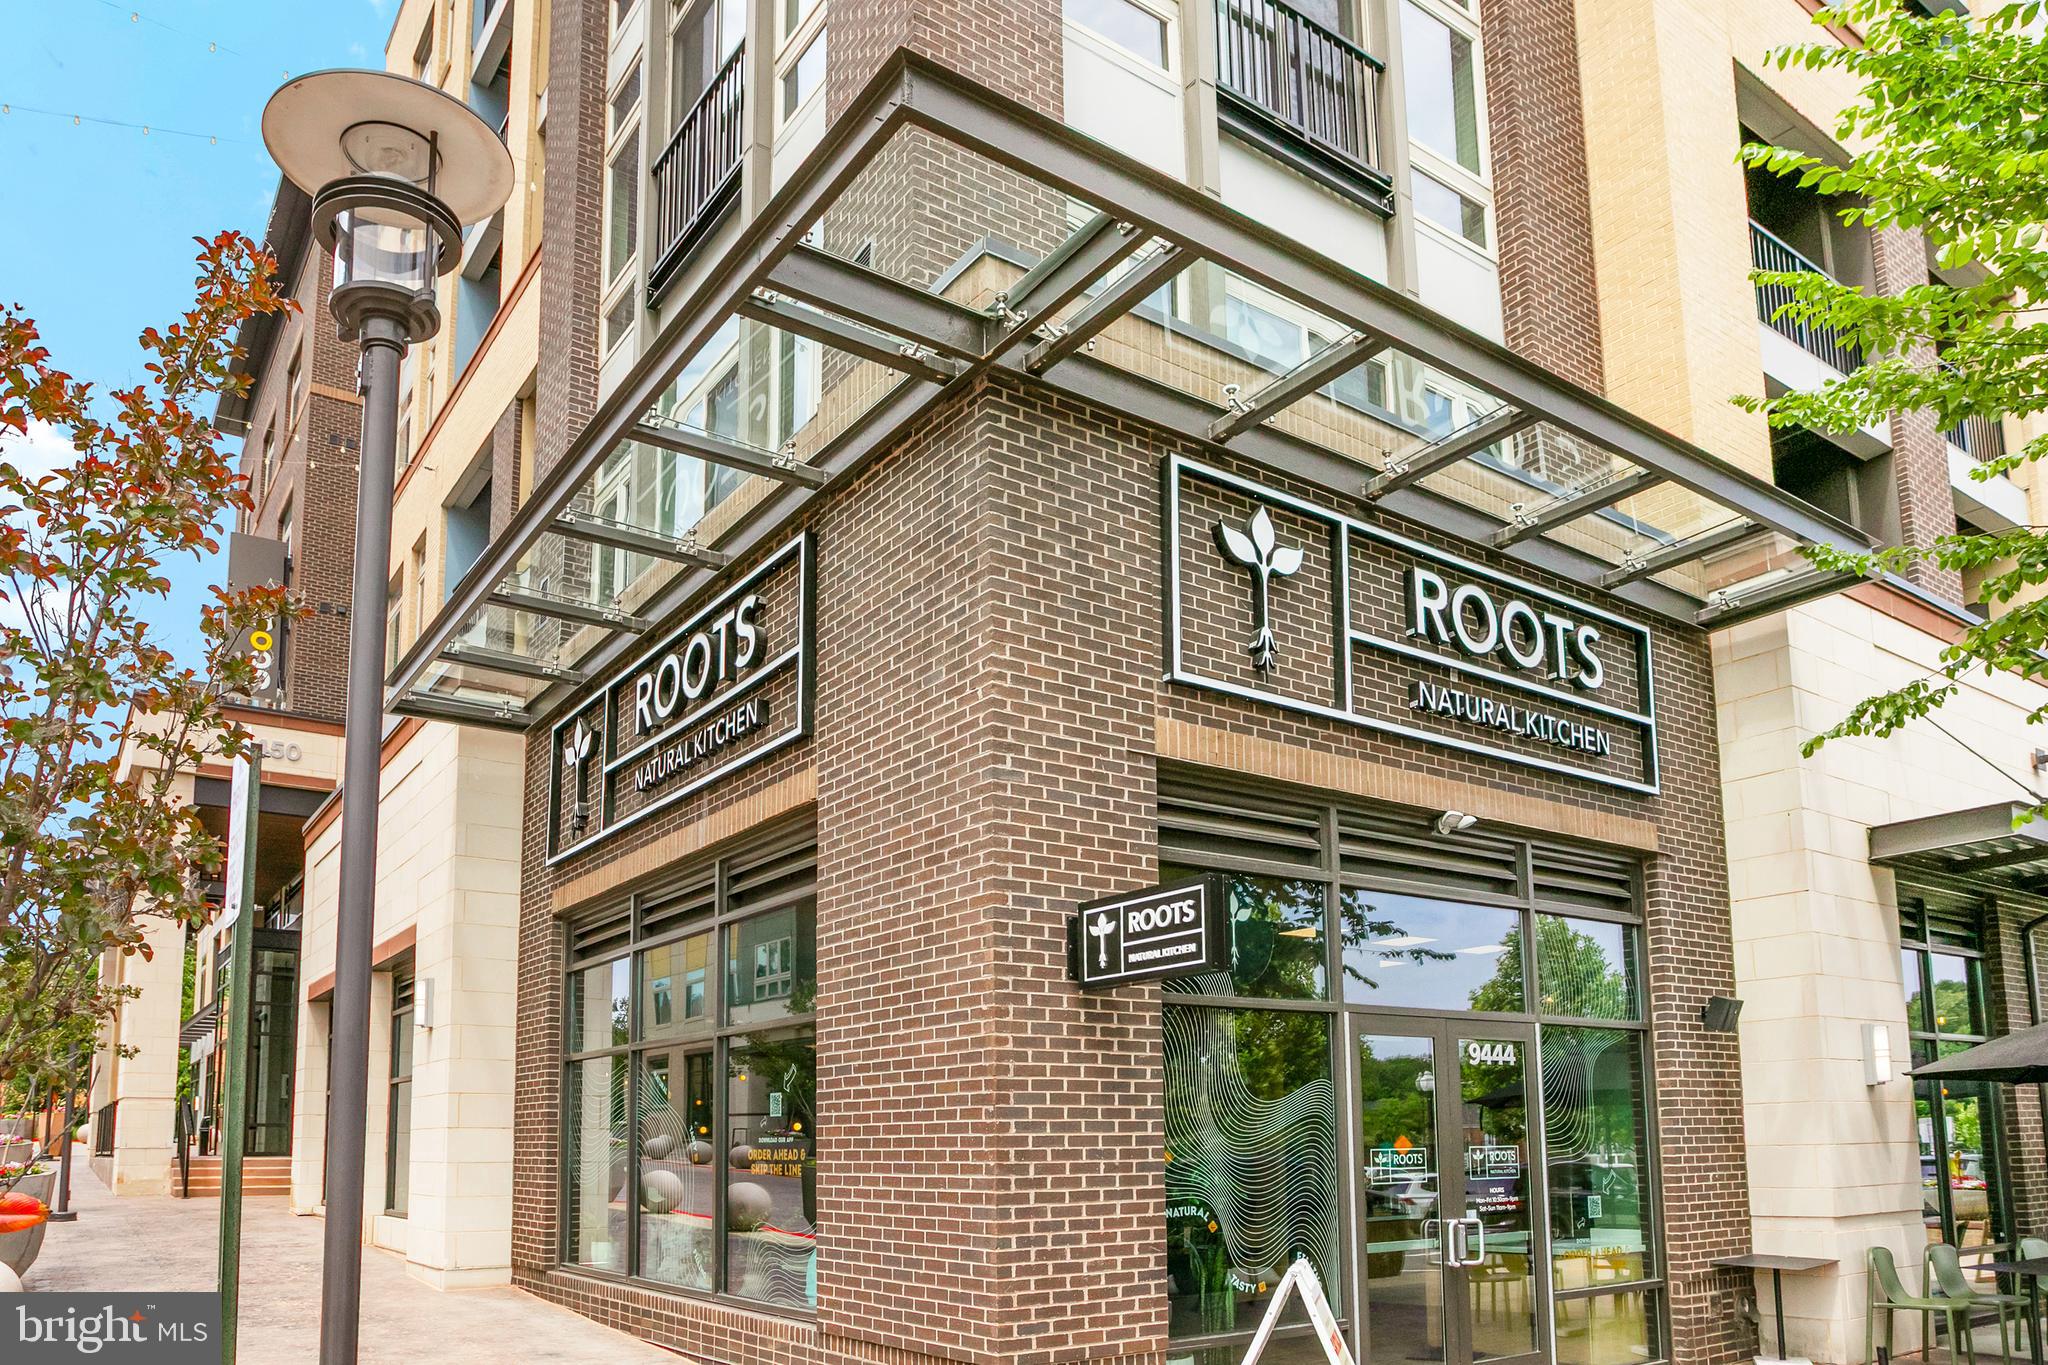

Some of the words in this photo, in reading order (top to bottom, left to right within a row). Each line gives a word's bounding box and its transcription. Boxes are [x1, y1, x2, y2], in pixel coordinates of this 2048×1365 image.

[1411, 567, 1604, 689] ROOTS
[634, 595, 760, 736] ROOTS
[1418, 681, 1522, 732] NATURAL
[1525, 711, 1610, 755] KITCHEN
[634, 741, 692, 792] NATURAL
[694, 698, 759, 757] KITCHEN
[1128, 899, 1196, 934] ROOTS
[1128, 948, 1163, 963] NATURAL
[1162, 943, 1197, 959] KITCHEN
[1468, 1043, 1517, 1066] 9444
[748, 1149, 771, 1161] ORDER
[773, 1149, 799, 1160] AHEAD
[1393, 1153, 1423, 1165] ROOTS
[1489, 1150, 1516, 1161] ROOTS
[751, 1163, 768, 1175] SKIP
[769, 1163, 783, 1175] THE
[784, 1163, 802, 1175] LINE
[1165, 1206, 1210, 1223] NATURAL
[1231, 1274, 1257, 1294] TASTY
